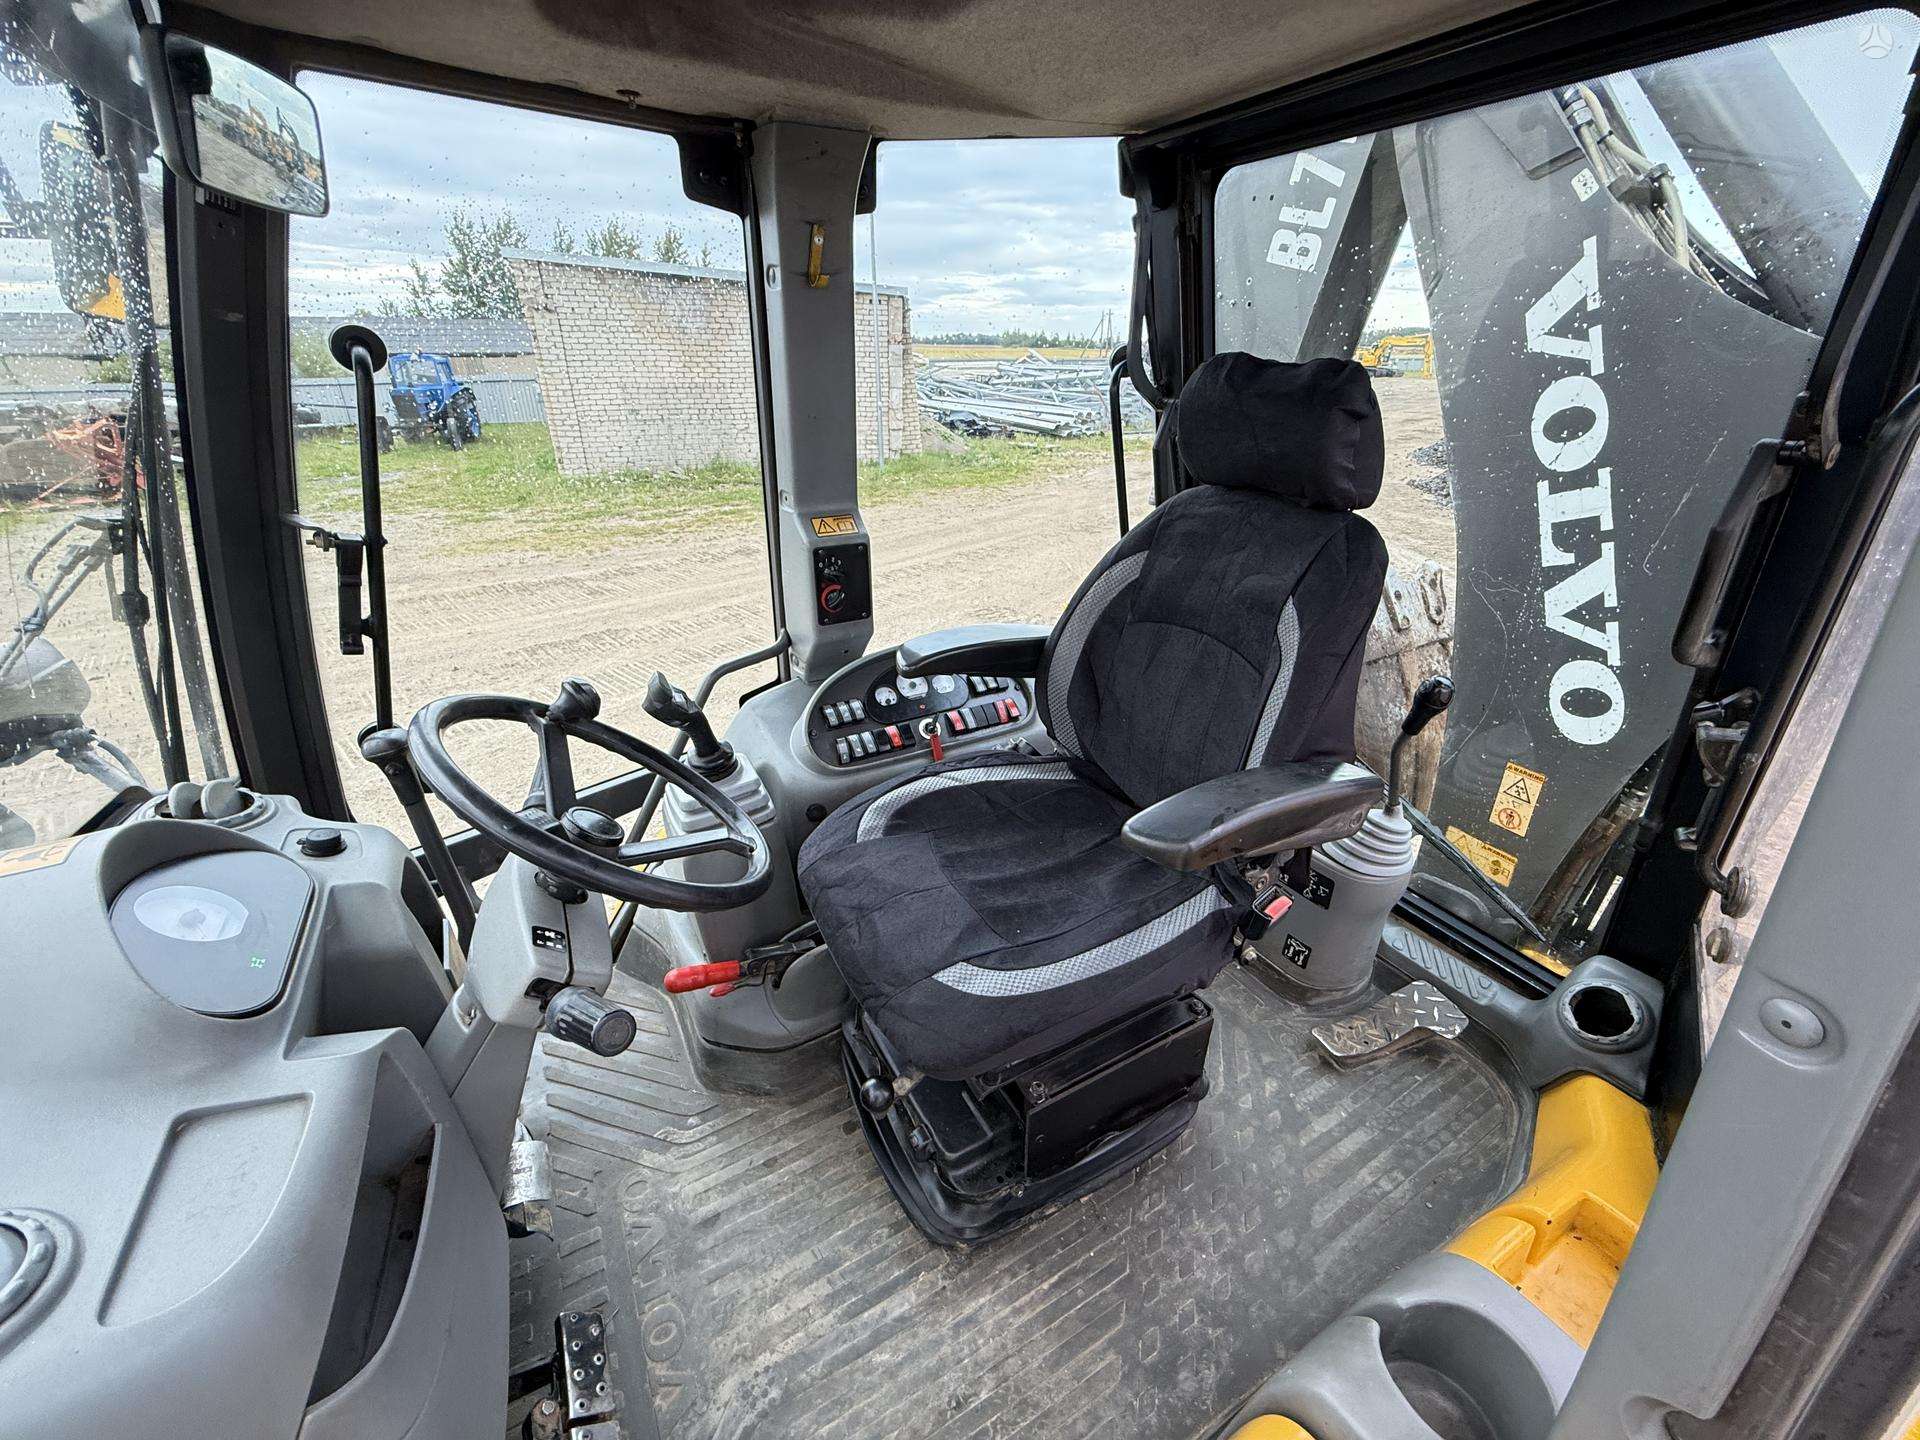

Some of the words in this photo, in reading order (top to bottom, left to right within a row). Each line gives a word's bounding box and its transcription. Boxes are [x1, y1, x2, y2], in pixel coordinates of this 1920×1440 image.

[1266, 135, 1358, 272] BL7
[1525, 235, 1625, 745] VOLVO
[1512, 765, 1544, 783] WARNING
